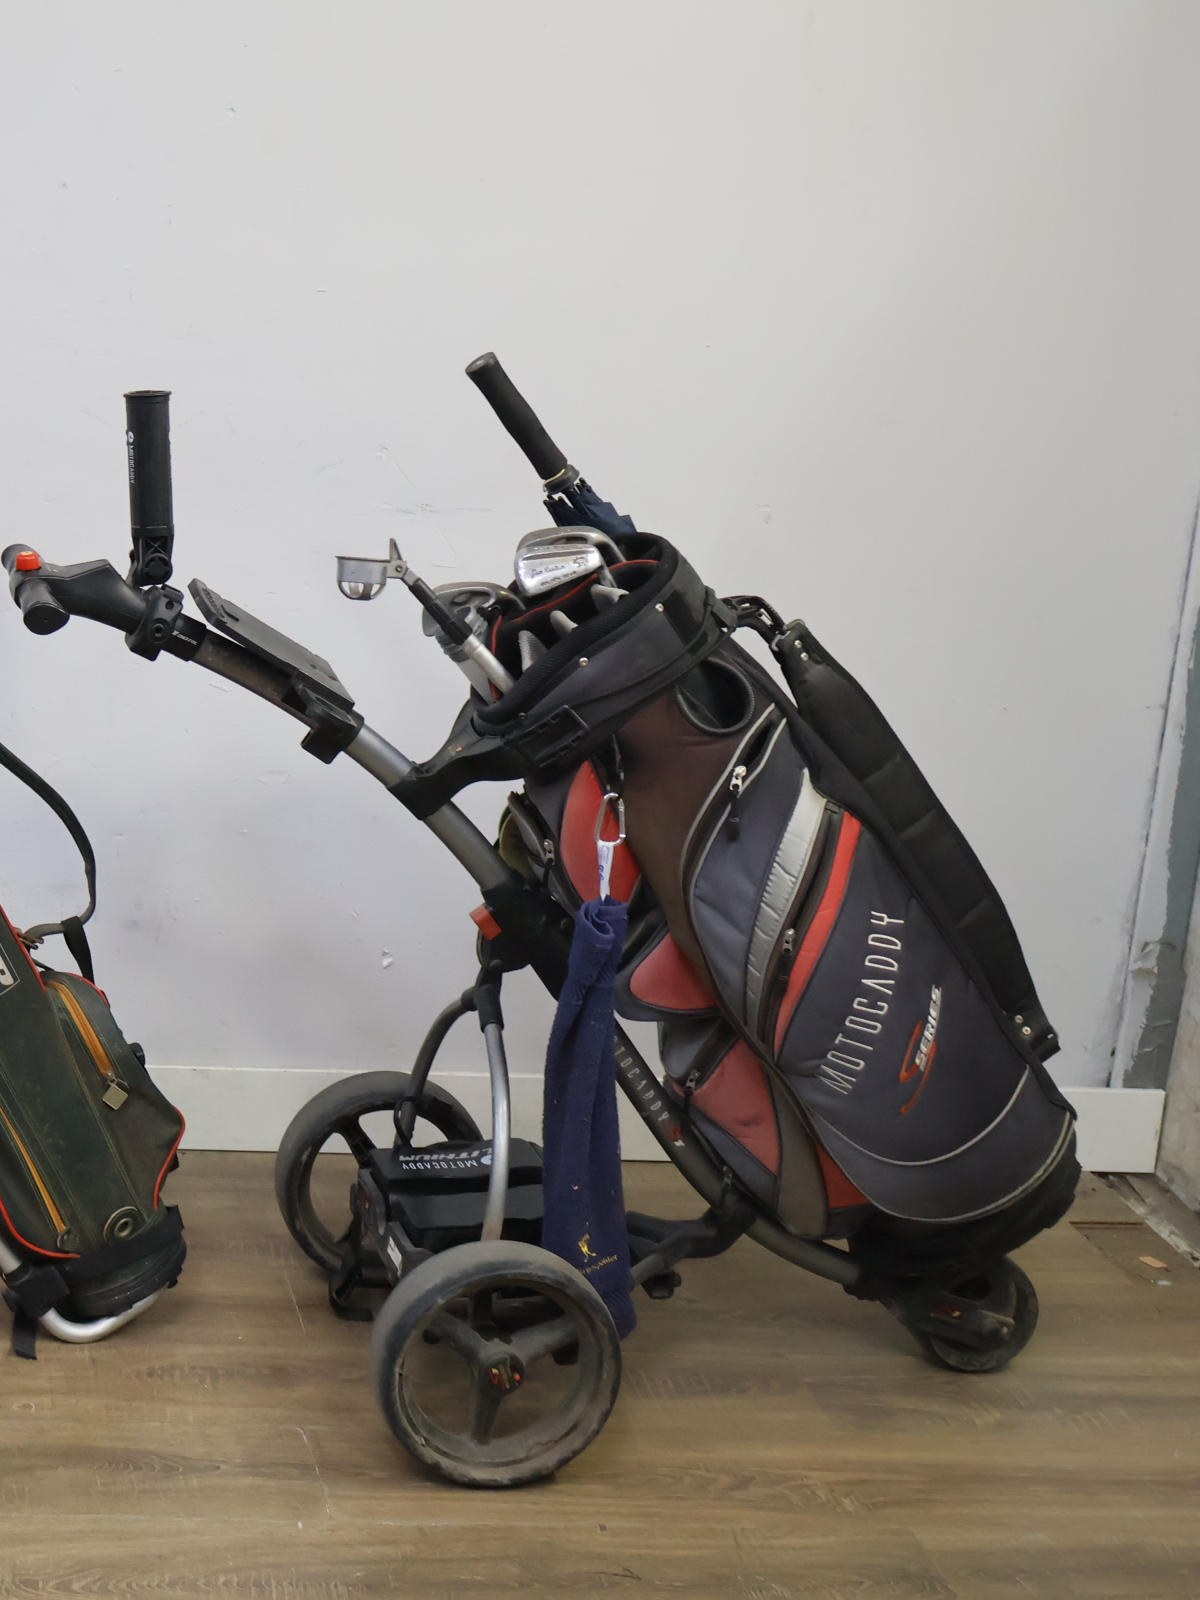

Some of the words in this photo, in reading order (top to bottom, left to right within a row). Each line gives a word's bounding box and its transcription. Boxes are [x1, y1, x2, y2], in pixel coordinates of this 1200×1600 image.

[818, 910, 905, 1095] MOTOCADDY
[914, 983, 942, 1072] SERIES
[613, 1035, 670, 1122] TOCADDY
[399, 1147, 492, 1161] LITHIUM
[402, 1159, 479, 1170] MOTOCADDY
